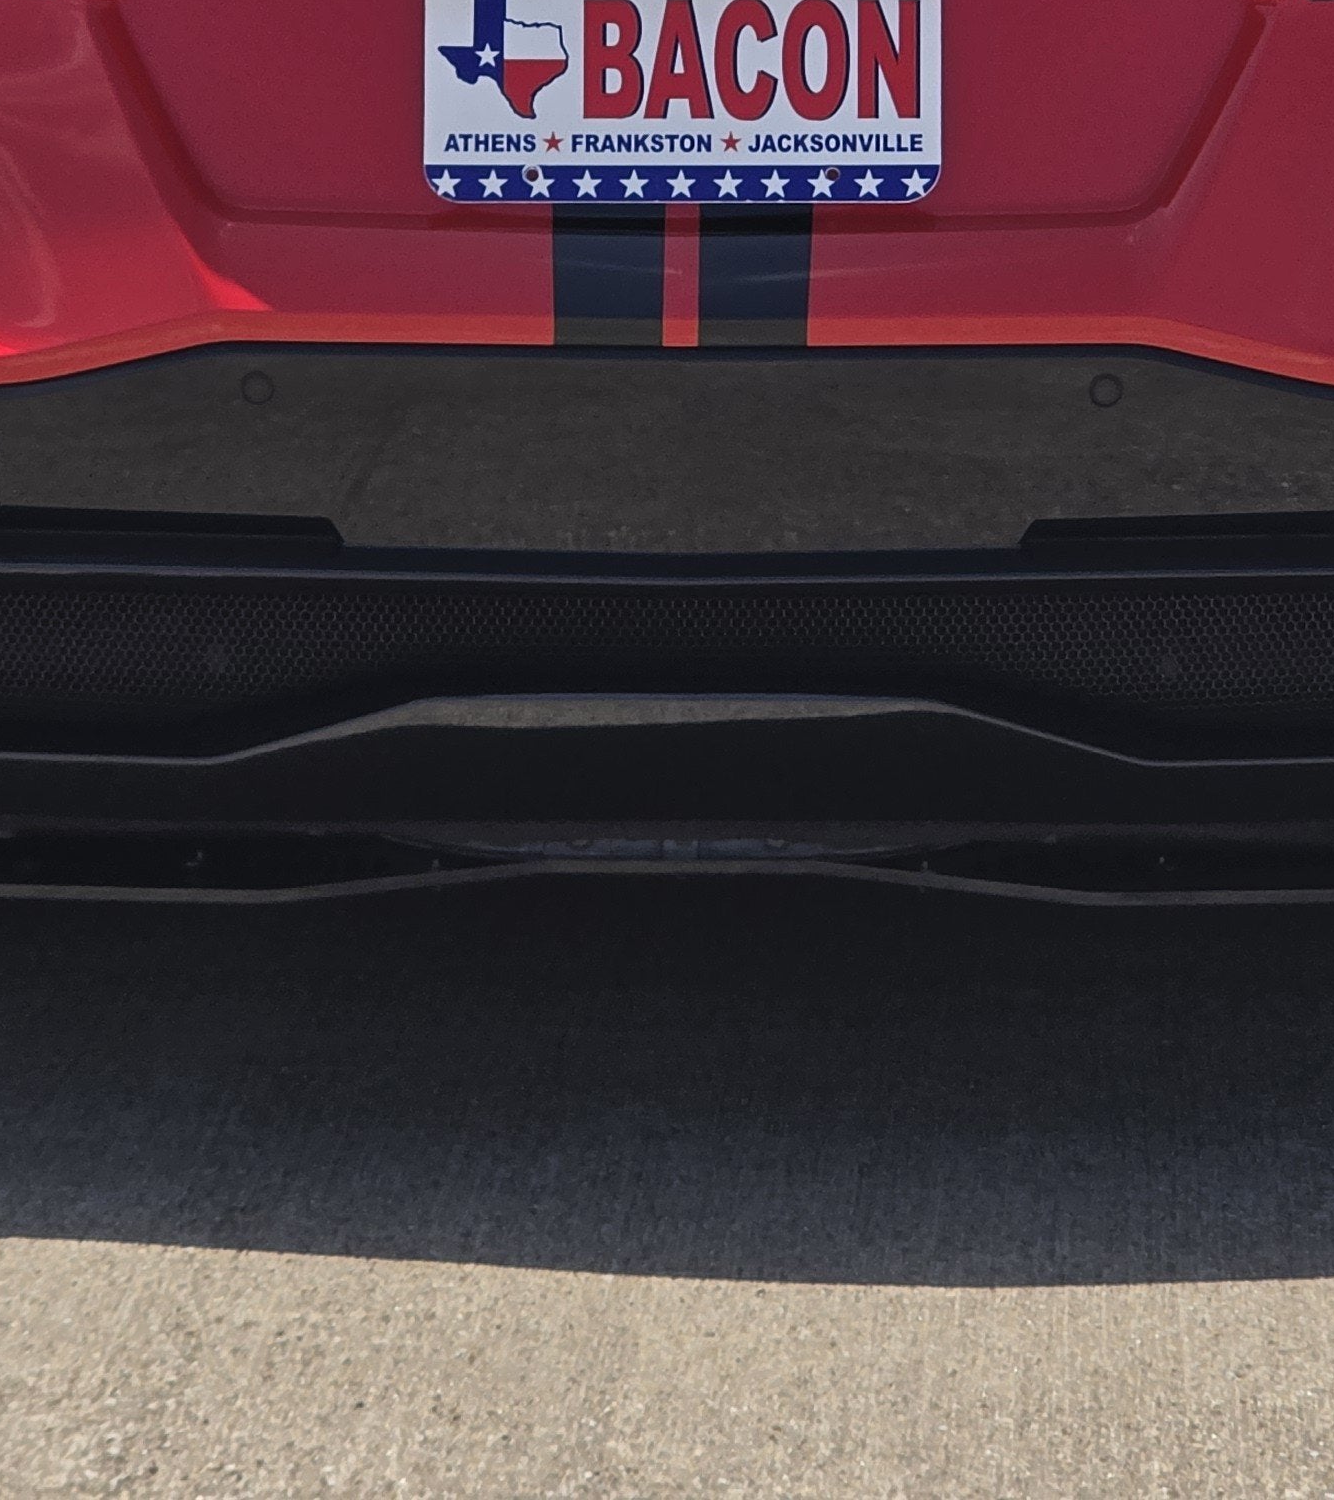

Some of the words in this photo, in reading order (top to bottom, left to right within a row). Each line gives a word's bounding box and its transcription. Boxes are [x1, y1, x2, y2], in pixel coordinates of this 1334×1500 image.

[443, 133, 537, 153] ATHENS
[570, 133, 713, 153] FRANKSTON
[747, 133, 924, 153] JACKSONVILLE
